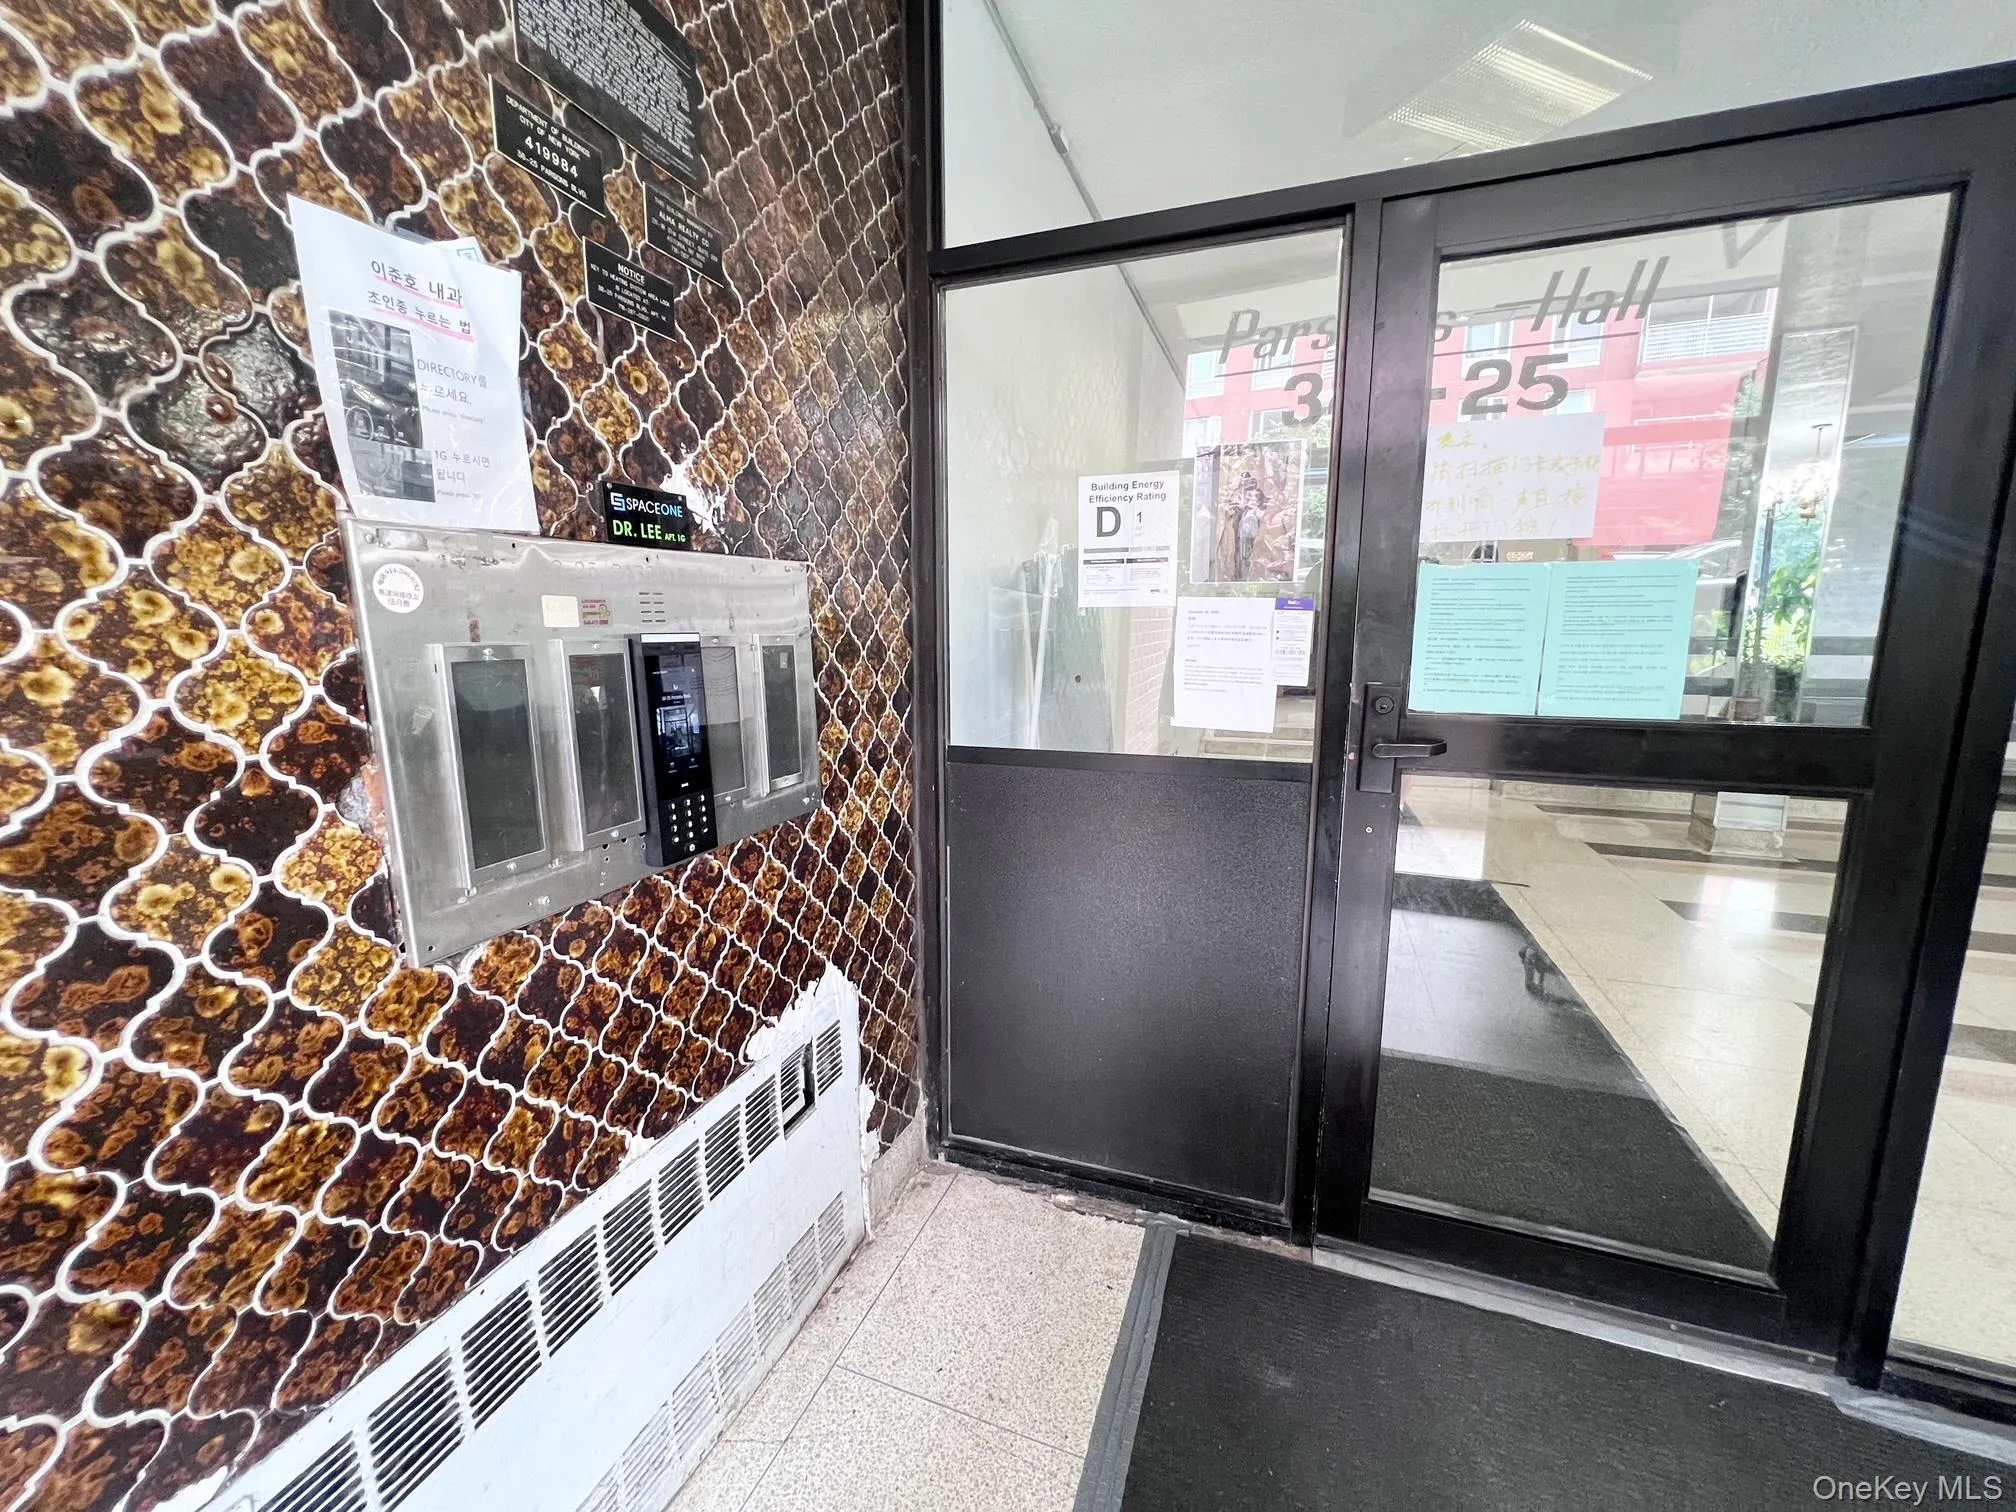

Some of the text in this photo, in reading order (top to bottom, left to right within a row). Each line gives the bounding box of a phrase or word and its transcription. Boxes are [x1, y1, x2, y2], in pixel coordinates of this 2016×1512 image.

[505, 94, 547, 129] DEPARTMENT
[550, 124, 558, 136] OF
[519, 114, 580, 160] CITY OF NEW YORK
[524, 133, 577, 178] 419984
[540, 164, 568, 187] PARSONS
[658, 209, 675, 226] ALMA
[678, 221, 699, 241] REALTY
[371, 260, 463, 305] 이준호 내과
[617, 262, 644, 284] NOTICE
[1530, 256, 1670, 332] Hall
[367, 290, 472, 334] 초인종 누르는 법
[434, 450, 448, 461] 1G
[1089, 491, 1166, 504] Efficiency Rating
[1091, 479, 1164, 491] Building Energy
[626, 497, 683, 518] SPACEONE
[1096, 506, 1121, 538] D
[612, 519, 637, 537] DR.
[640, 523, 662, 540] LEE
